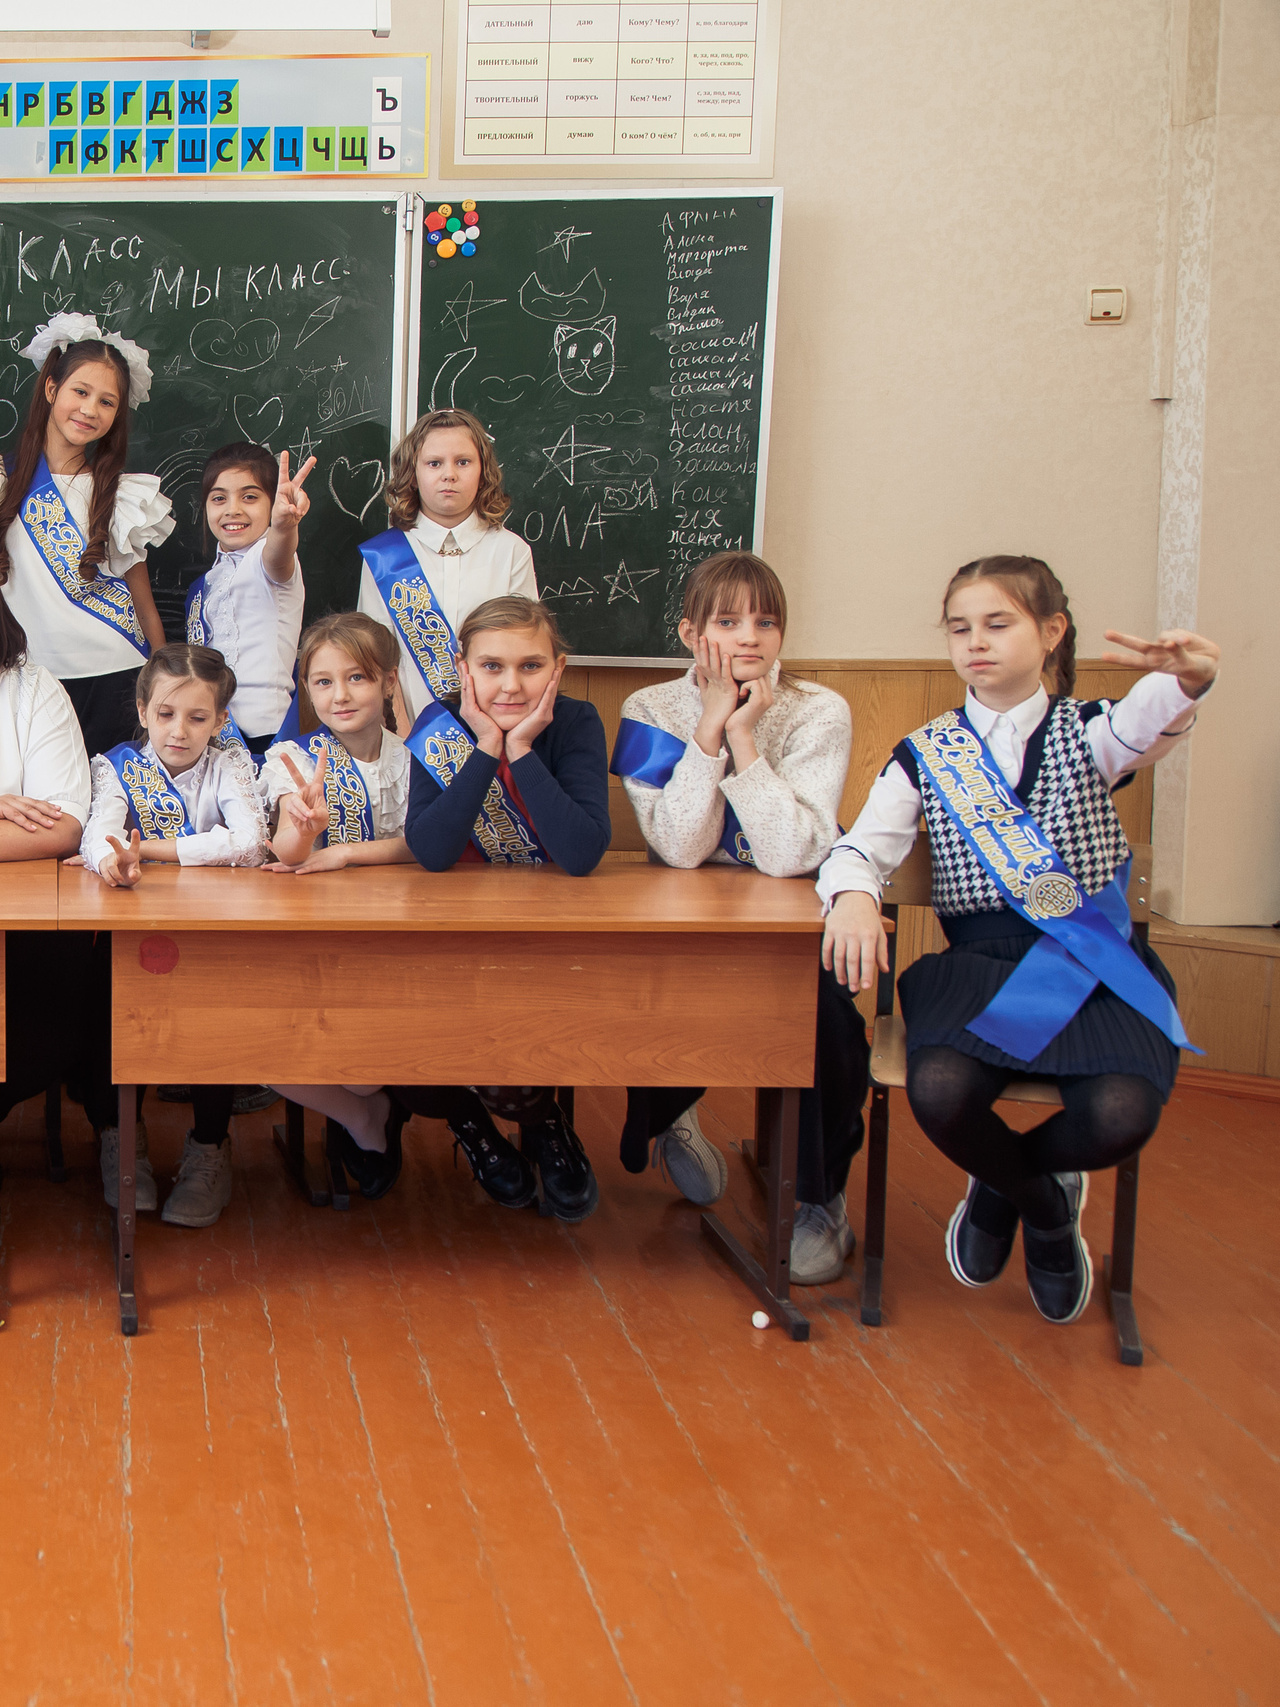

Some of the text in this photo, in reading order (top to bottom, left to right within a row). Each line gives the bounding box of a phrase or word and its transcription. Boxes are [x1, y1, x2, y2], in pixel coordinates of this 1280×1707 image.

[484, 18, 534, 28] ДАТЕЛЬНЫЙ
[576, 18, 593, 27] даю
[628, 17, 680, 27] Кому? Чему?
[477, 57, 538, 67] ВИНИТЕЛЬНЫЙ
[572, 56, 594, 65] вижу
[630, 56, 675, 65] Кого? Что?
[376, 88, 398, 111] Ъ
[474, 94, 539, 105] ТВОРИТЕЛЬНЫЙ
[565, 93, 599, 102] горжусь
[630, 94, 672, 103] Кем? Чем?
[24, 94, 39, 116] Р
[57, 93, 72, 115] Б
[89, 93, 104, 115] В
[123, 92, 135, 114] Г
[149, 92, 171, 120] Д
[181, 91, 205, 113] Ж
[218, 91, 232, 114] З
[477, 130, 534, 141] ПРЕДЛОЖНЫЙ
[566, 131, 594, 140] думаю
[621, 131, 677, 140] О ком? О чём?
[56, 138, 366, 166] П Ф К Т Ш С Х Ц Ч Щ
[378, 136, 396, 160] Ь
[17, 231, 144, 294] КЛАСС
[149, 265, 221, 313] МЫ
[31, 524, 134, 634] начальной школы
[396, 611, 449, 698] начальной
[931, 726, 1052, 882] Выпускник
[971, 826, 1027, 898] школы
